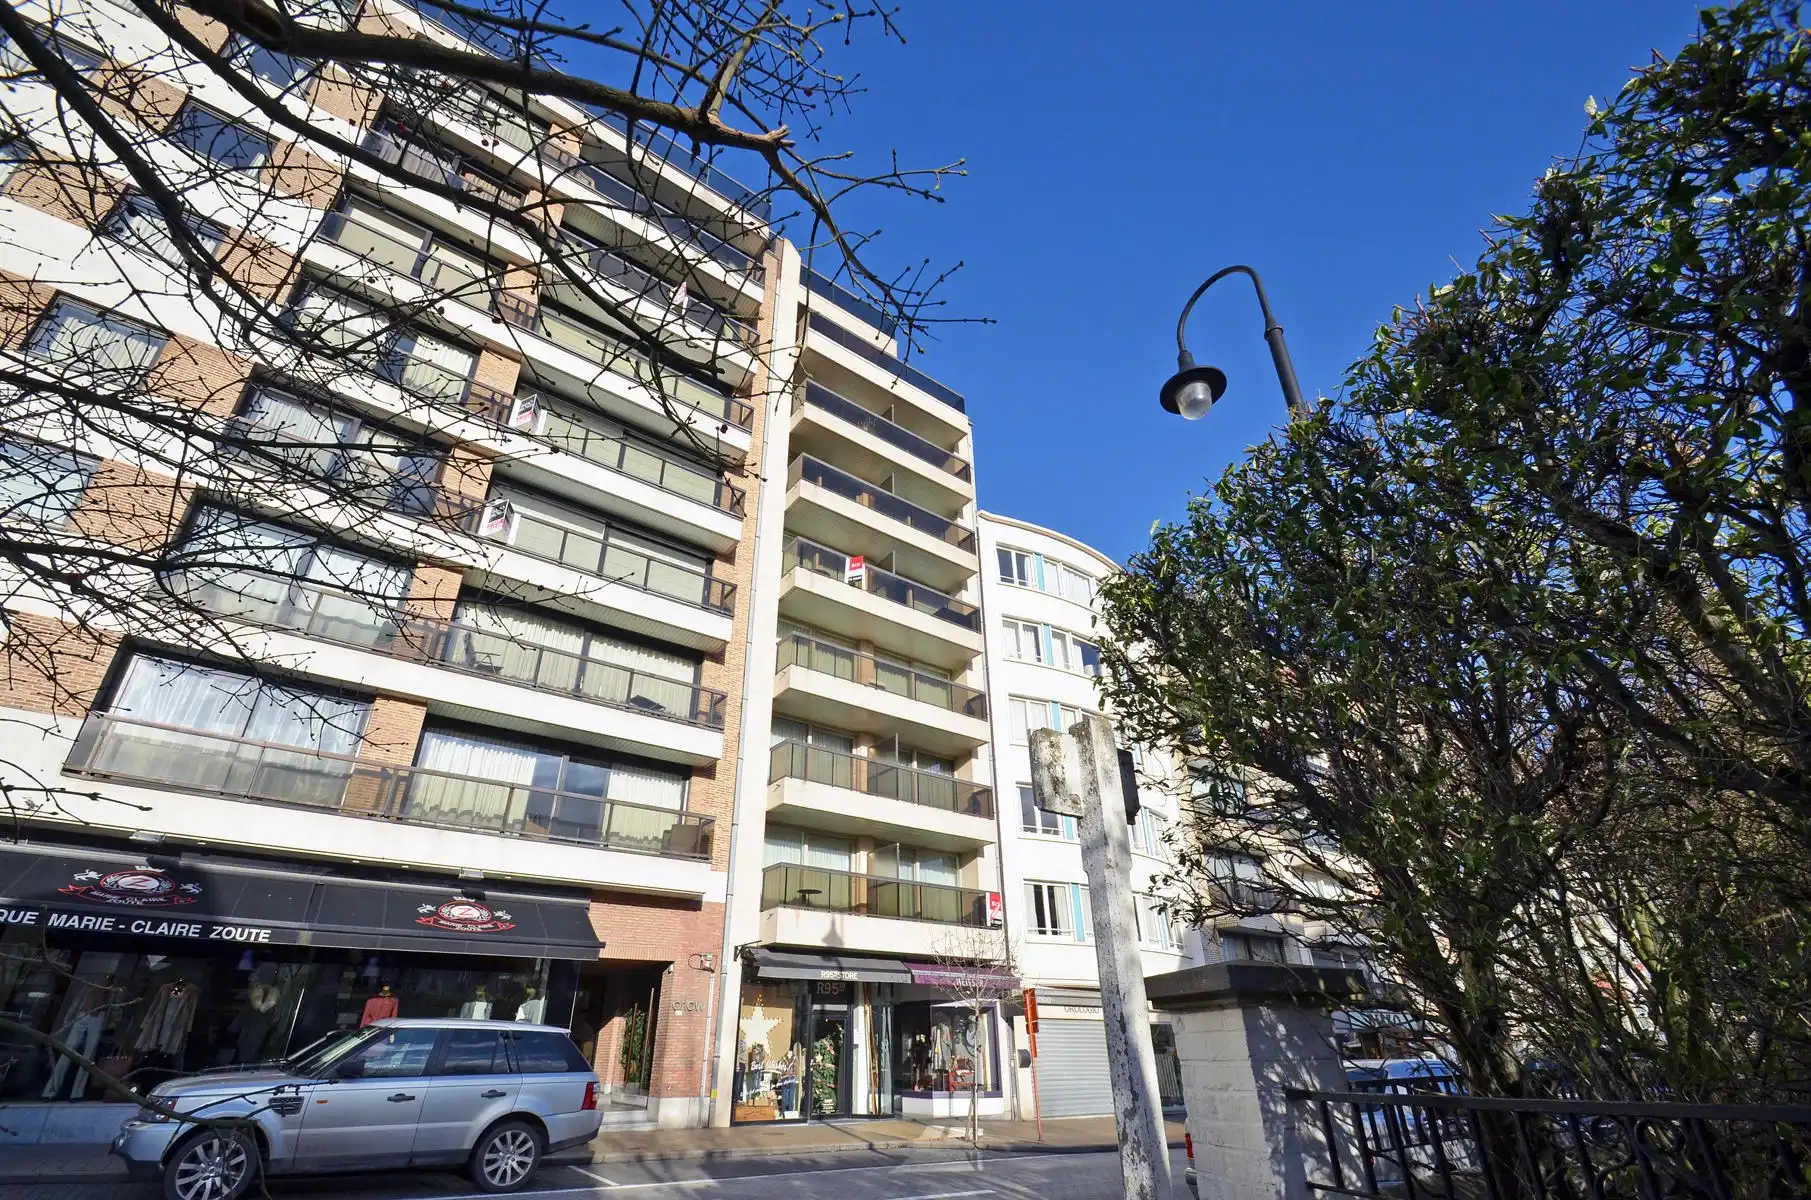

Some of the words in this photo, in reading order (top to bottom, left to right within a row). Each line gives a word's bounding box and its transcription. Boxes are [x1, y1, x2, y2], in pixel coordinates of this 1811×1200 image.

[48, 913, 116, 931] MARIE
[130, 920, 202, 938] CLAIRE
[208, 925, 272, 942] ZOUTE
[837, 971, 859, 980] STORE
